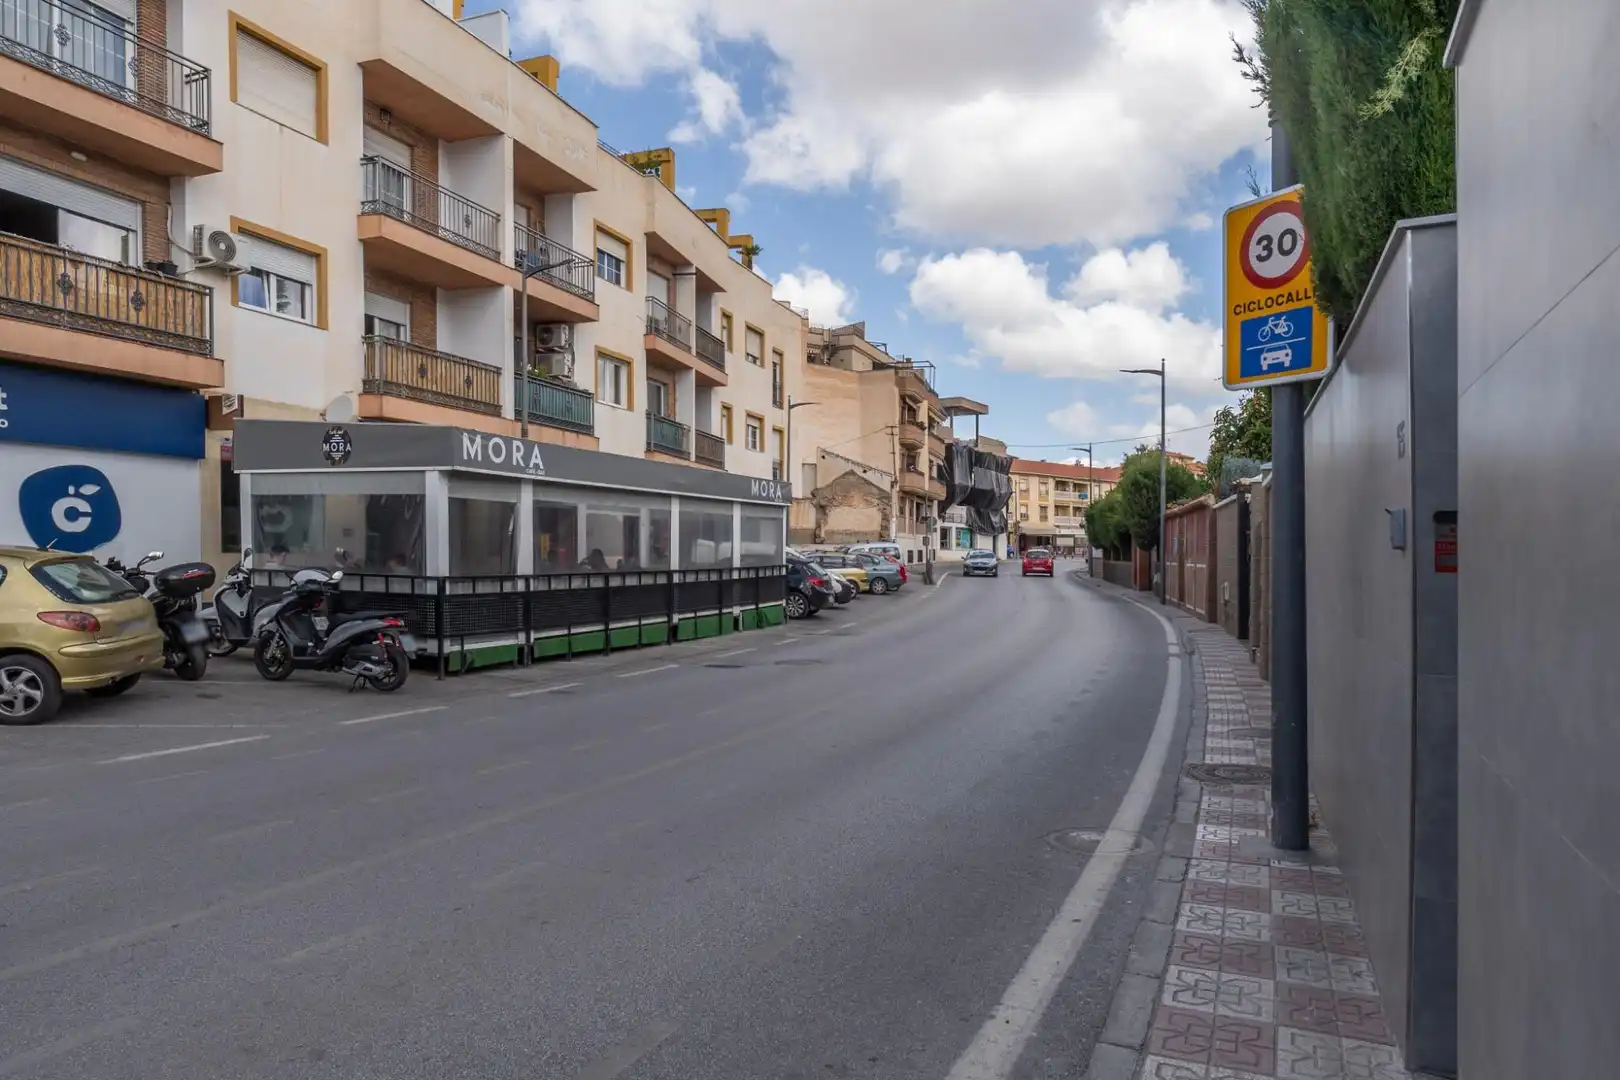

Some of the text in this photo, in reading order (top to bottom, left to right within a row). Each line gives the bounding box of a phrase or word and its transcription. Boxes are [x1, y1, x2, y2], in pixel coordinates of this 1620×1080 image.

[1255, 228, 1298, 263] 30
[322, 443, 352, 452] MORA
[462, 432, 545, 470] MORA
[751, 479, 782, 499] MORA
